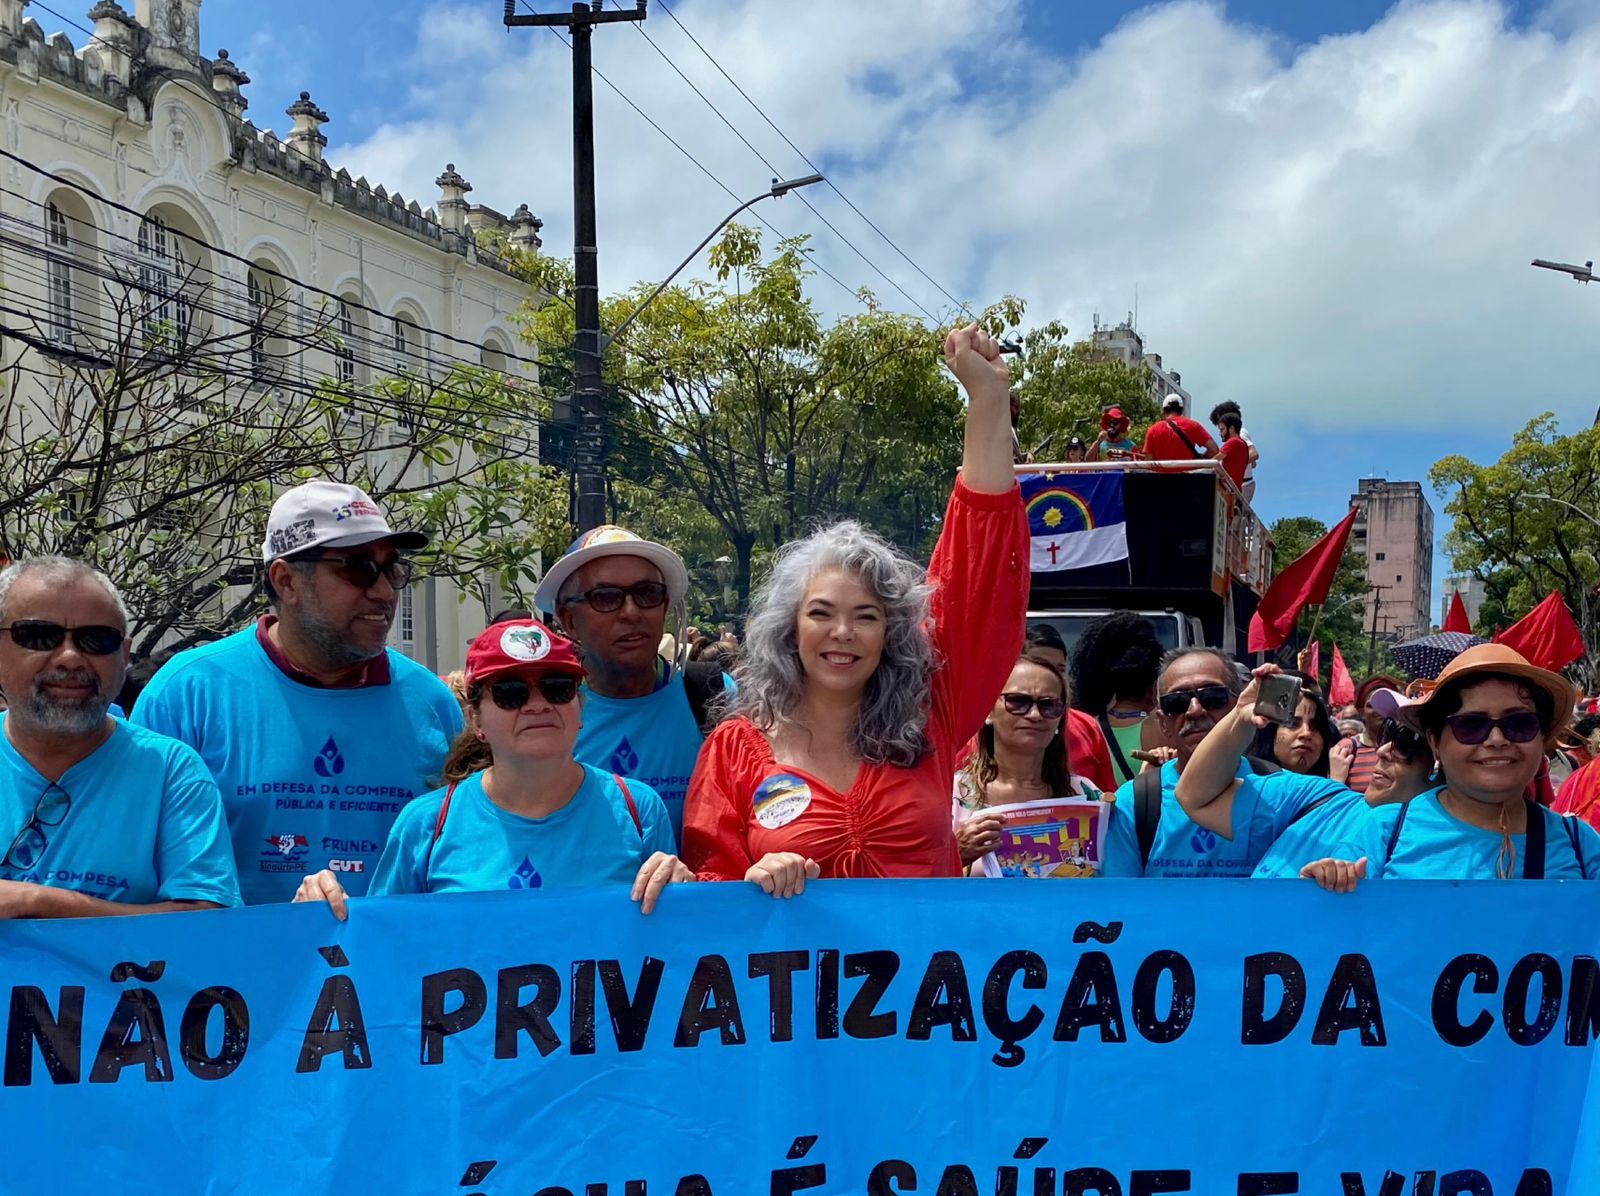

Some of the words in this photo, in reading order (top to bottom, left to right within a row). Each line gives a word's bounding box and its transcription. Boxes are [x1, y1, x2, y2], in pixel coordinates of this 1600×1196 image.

[237, 785, 257, 796] EM
[262, 783, 316, 795] DEFESA
[320, 784, 340, 796] DA
[345, 785, 415, 800] COMPESA
[275, 797, 324, 811] PÚBLICA
[340, 800, 400, 813] EFICIENTE
[4, 960, 250, 1087] NÃO
[296, 944, 373, 1074] À
[420, 921, 1197, 1068] PRIVATIZAÇÃO
[1241, 952, 1388, 1048] DA
